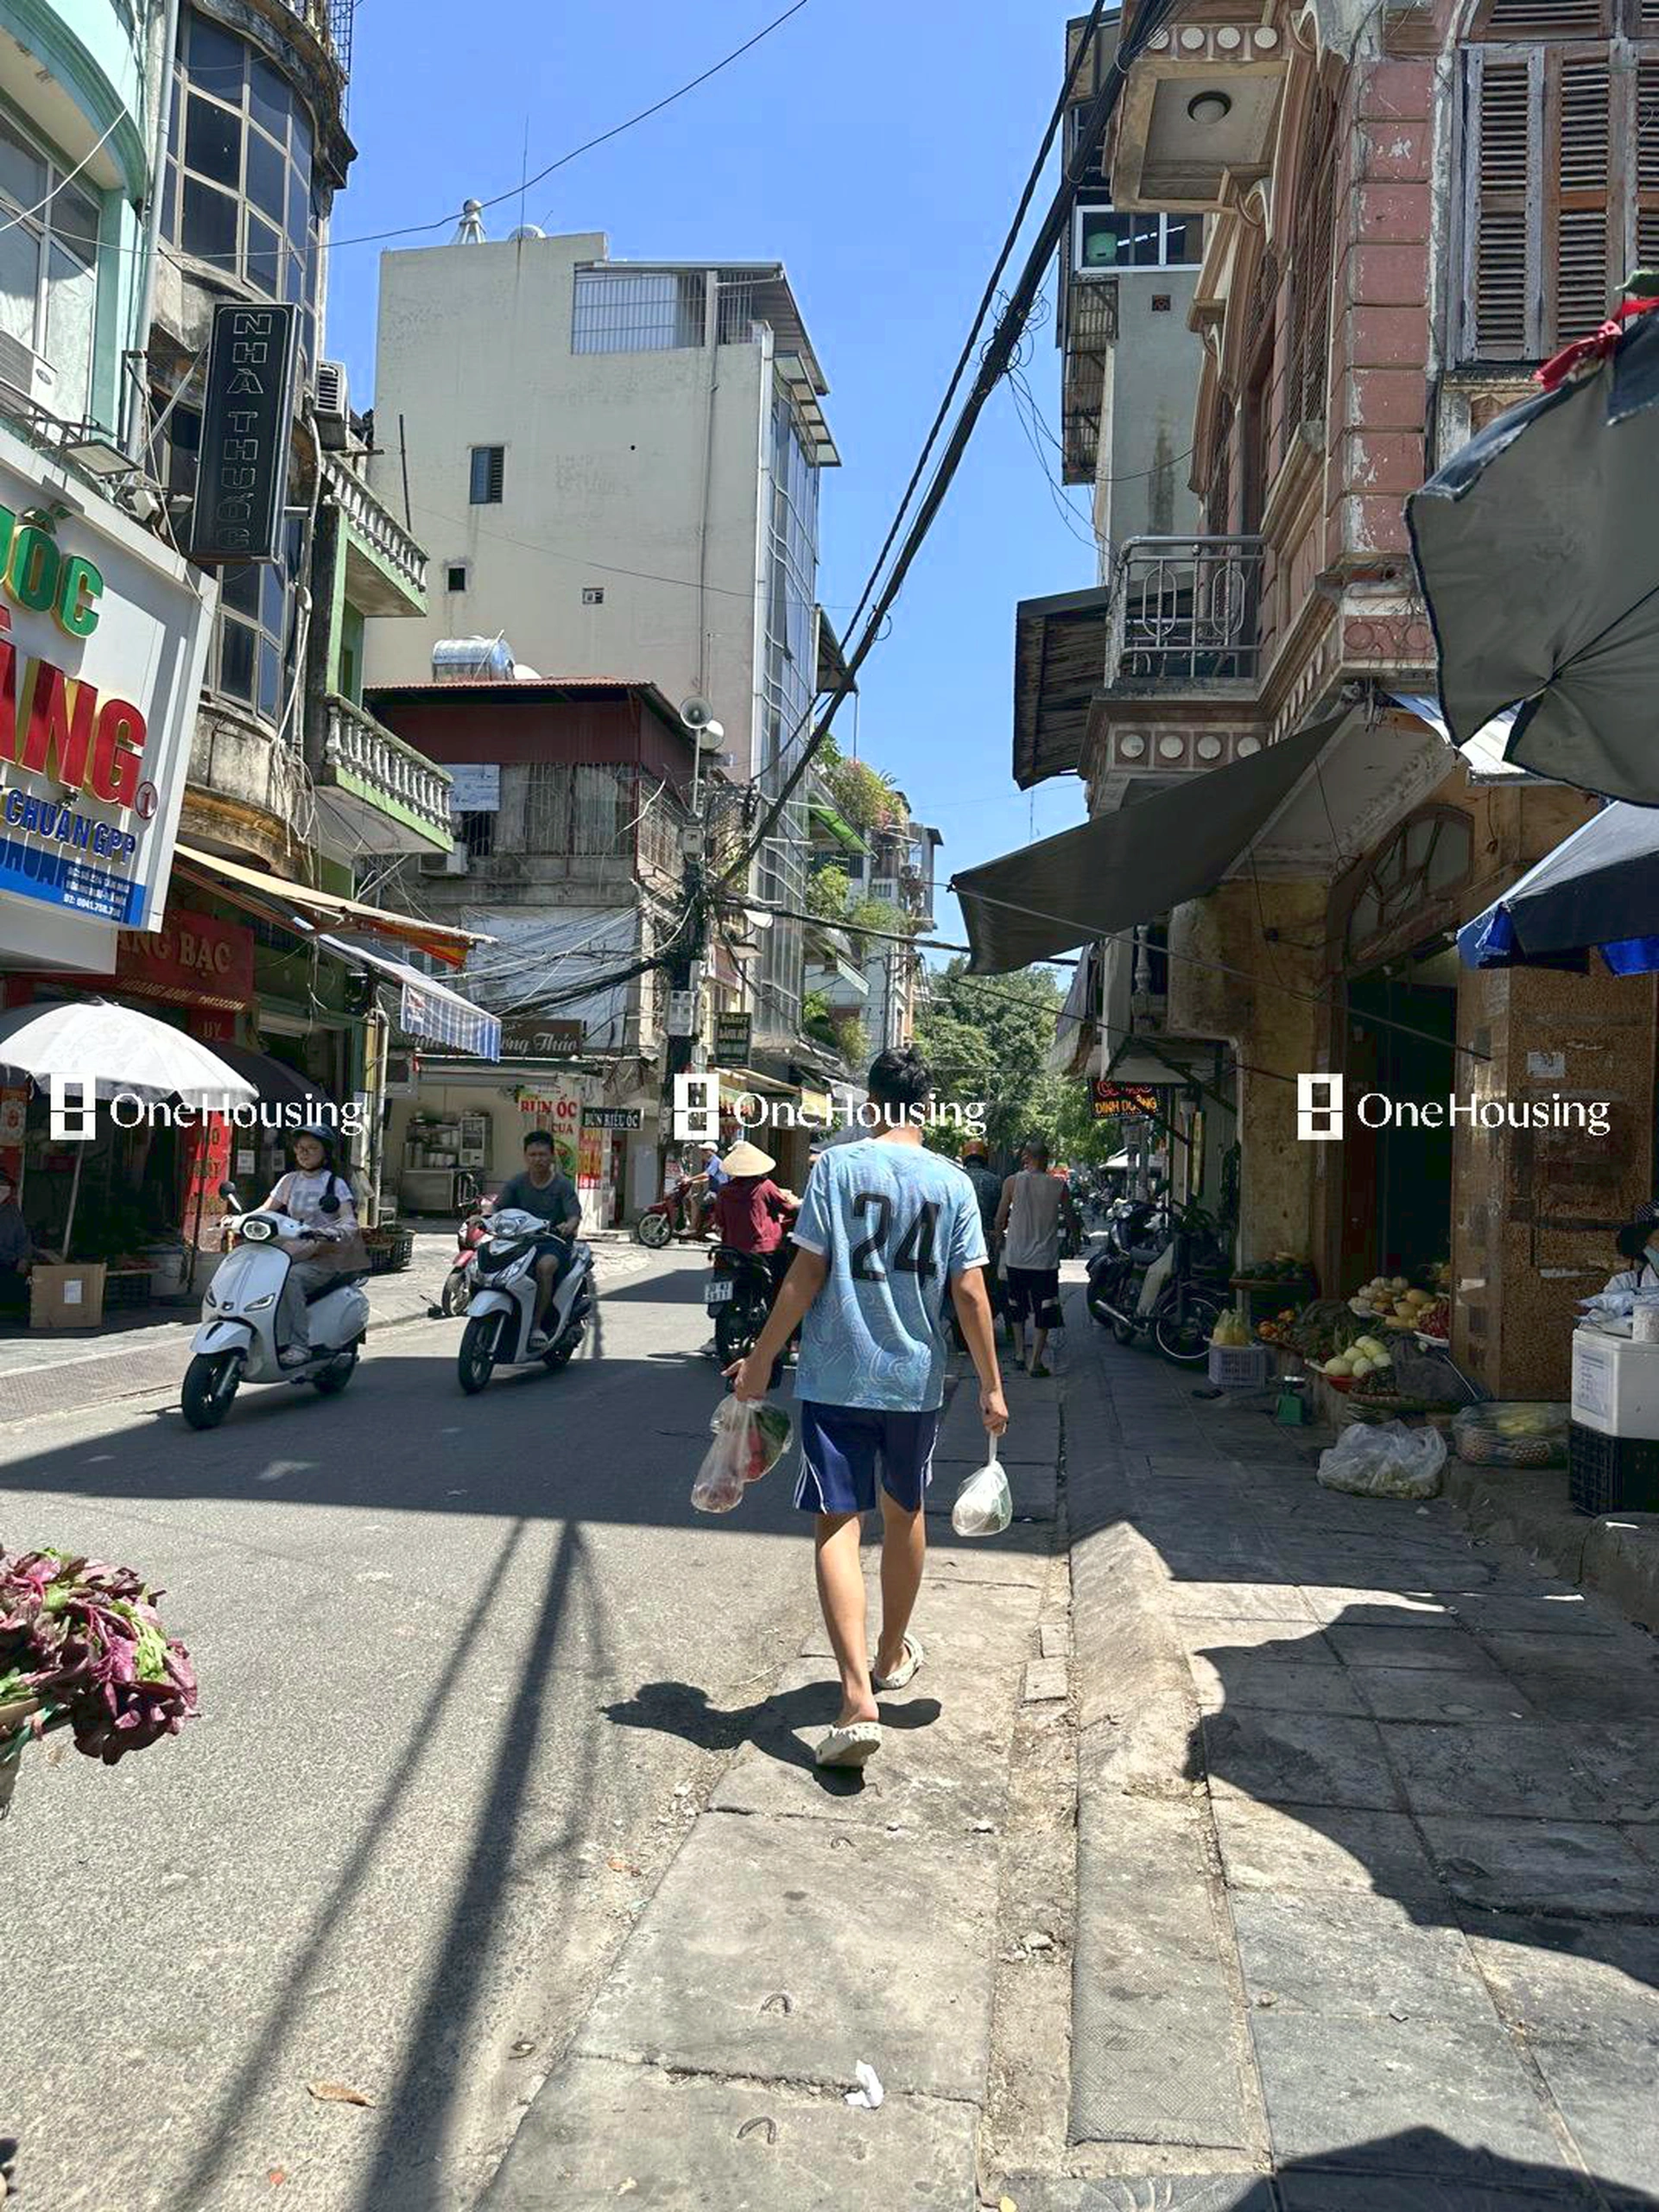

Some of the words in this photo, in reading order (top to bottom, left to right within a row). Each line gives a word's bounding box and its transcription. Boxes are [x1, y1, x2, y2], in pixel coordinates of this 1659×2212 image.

[226, 314, 272, 394] NHÀ
[93, 821, 136, 865] GPP
[851, 1192, 941, 1289] 24
